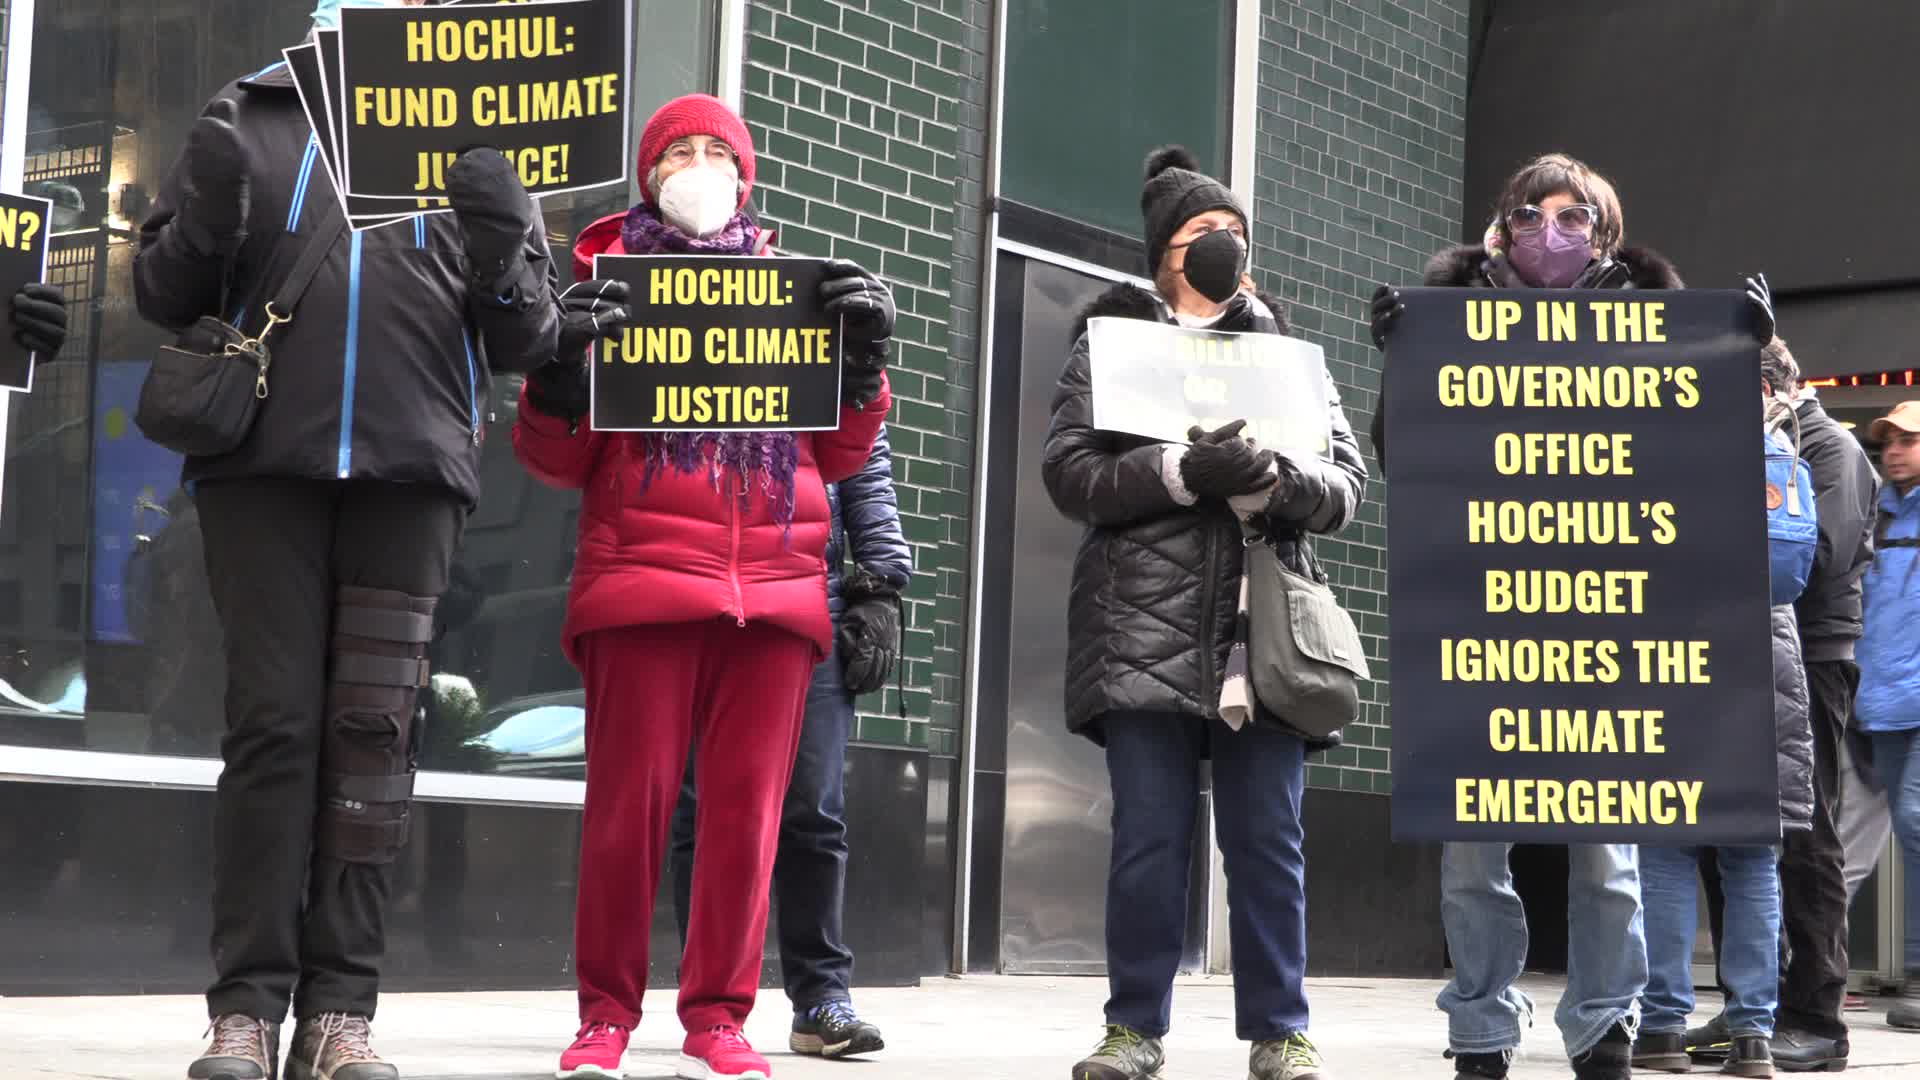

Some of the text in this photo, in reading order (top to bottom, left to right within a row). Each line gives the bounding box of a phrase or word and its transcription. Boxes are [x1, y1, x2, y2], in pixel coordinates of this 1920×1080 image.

[406, 16, 575, 62] HOCHUL:
[354, 73, 619, 128] FUND CLIMATE
[414, 144, 569, 190] JUCE!
[649, 268, 793, 305] HOCHUL:
[1467, 300, 1666, 342] UP IN THE
[603, 327, 832, 364] FUND CLIMATE
[652, 386, 789, 423] JUSTICE!
[1438, 364, 1700, 408] GOVERNOR’S
[1494, 433, 1634, 475] OFFICE
[1468, 501, 1677, 544] HOCHUL’S
[1485, 569, 1648, 614] BUDGET
[1441, 639, 1711, 683] IGNORES THE
[1489, 708, 1665, 753] CLIMATE
[1455, 778, 1704, 824] EMERGENCY
